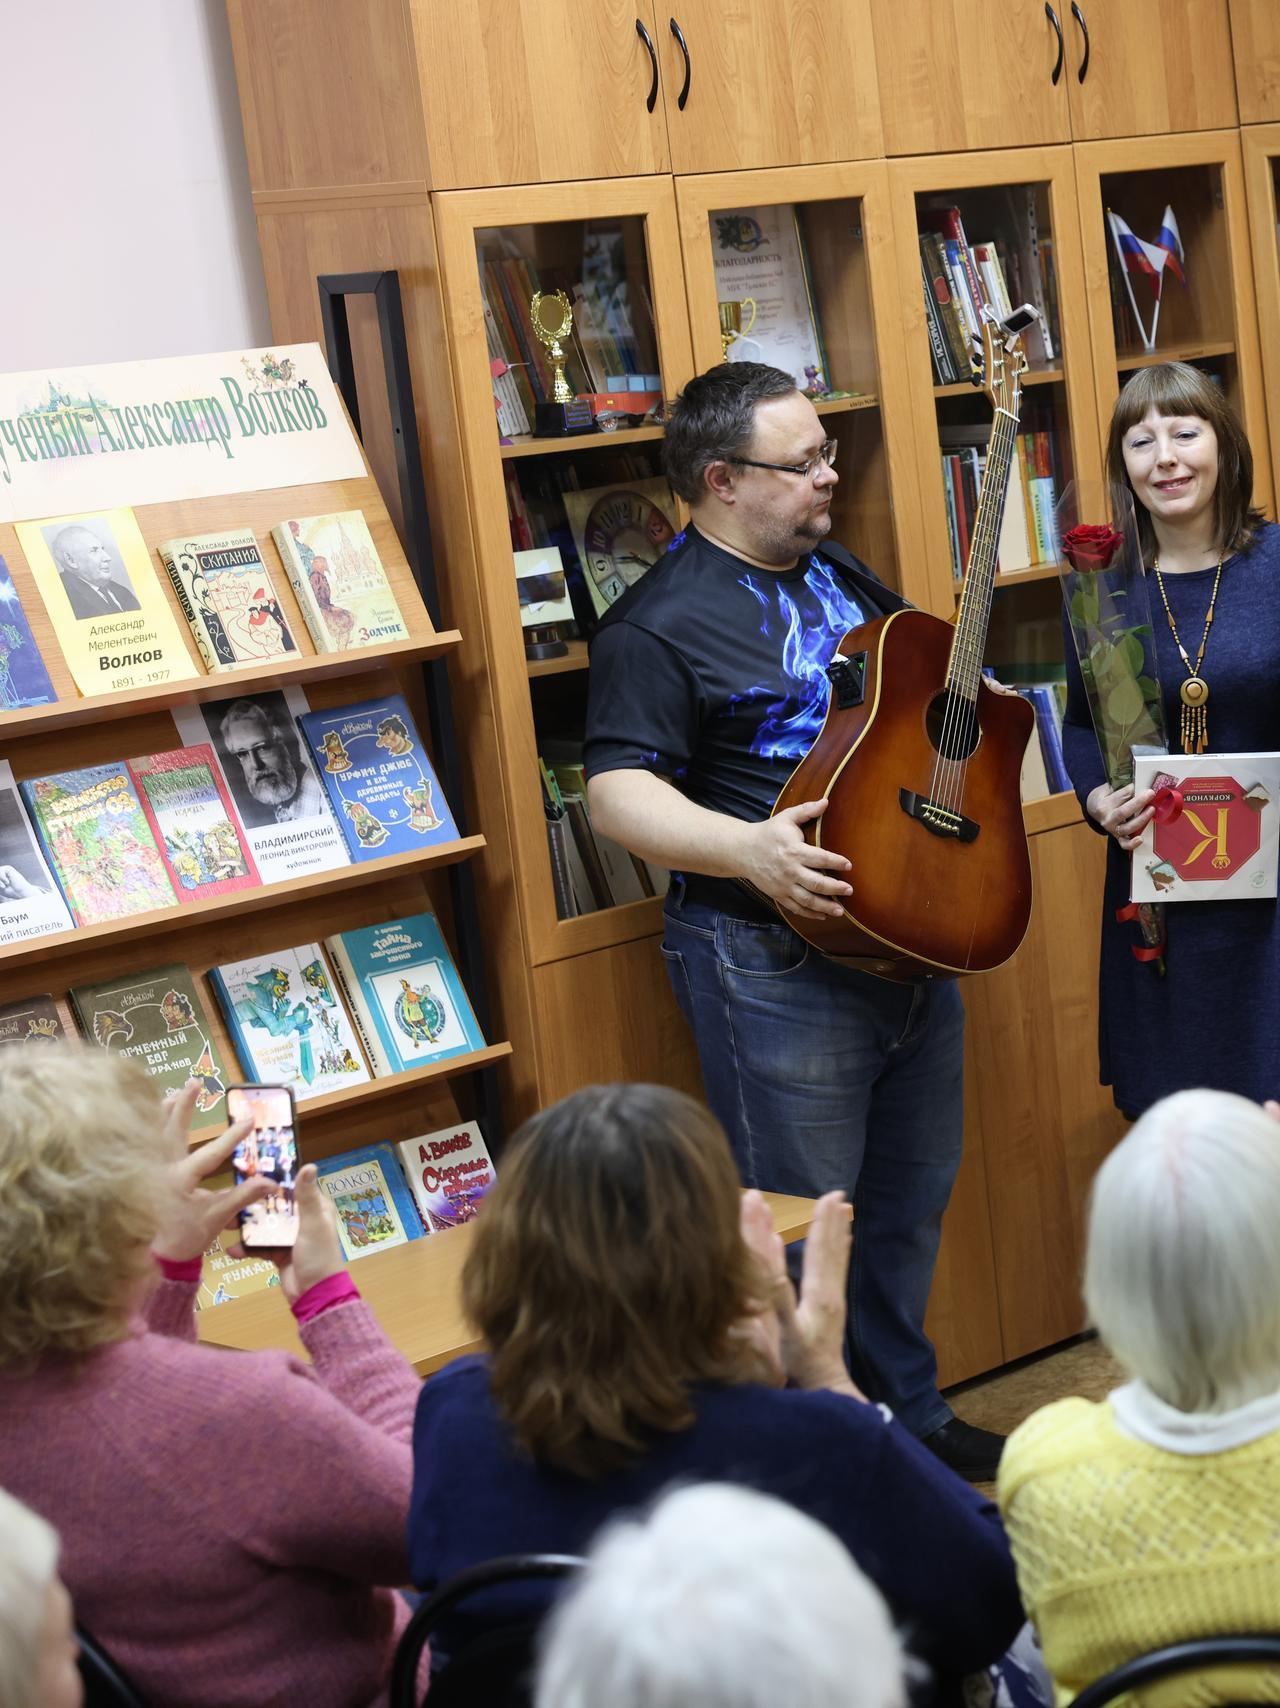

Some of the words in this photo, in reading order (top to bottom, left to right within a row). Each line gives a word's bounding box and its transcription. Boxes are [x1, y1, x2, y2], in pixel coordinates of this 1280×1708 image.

[88, 391, 235, 459] Александр
[220, 376, 328, 438] Волков
[194, 540, 229, 552] АЛЕКСАНДР
[231, 536, 254, 547] ВОЛКОВ
[200, 548, 260, 570] СКИТАНИЯ
[167, 560, 195, 622] СКИТАНИЯ
[89, 619, 145, 636] Александр
[88, 631, 158, 652] Мелентьевич
[99, 649, 163, 671] Волков
[111, 676, 135, 689] 1891
[147, 669, 171, 682] 1977
[339, 767, 377, 782] УРФИН
[254, 826, 334, 851] ВЛАДИМИРСКИЙ
[260, 848, 291, 862] ЛЕОНИД
[291, 839, 339, 857] ВИКТОРОВИЧ
[286, 857, 323, 870] художник
[1, 912, 29, 926] Баум
[16, 920, 63, 939] писатель
[146, 1050, 169, 1065] БОГ
[327, 1169, 379, 1195] ВОЛКОВ
[222, 1261, 274, 1284] ТУМАН
